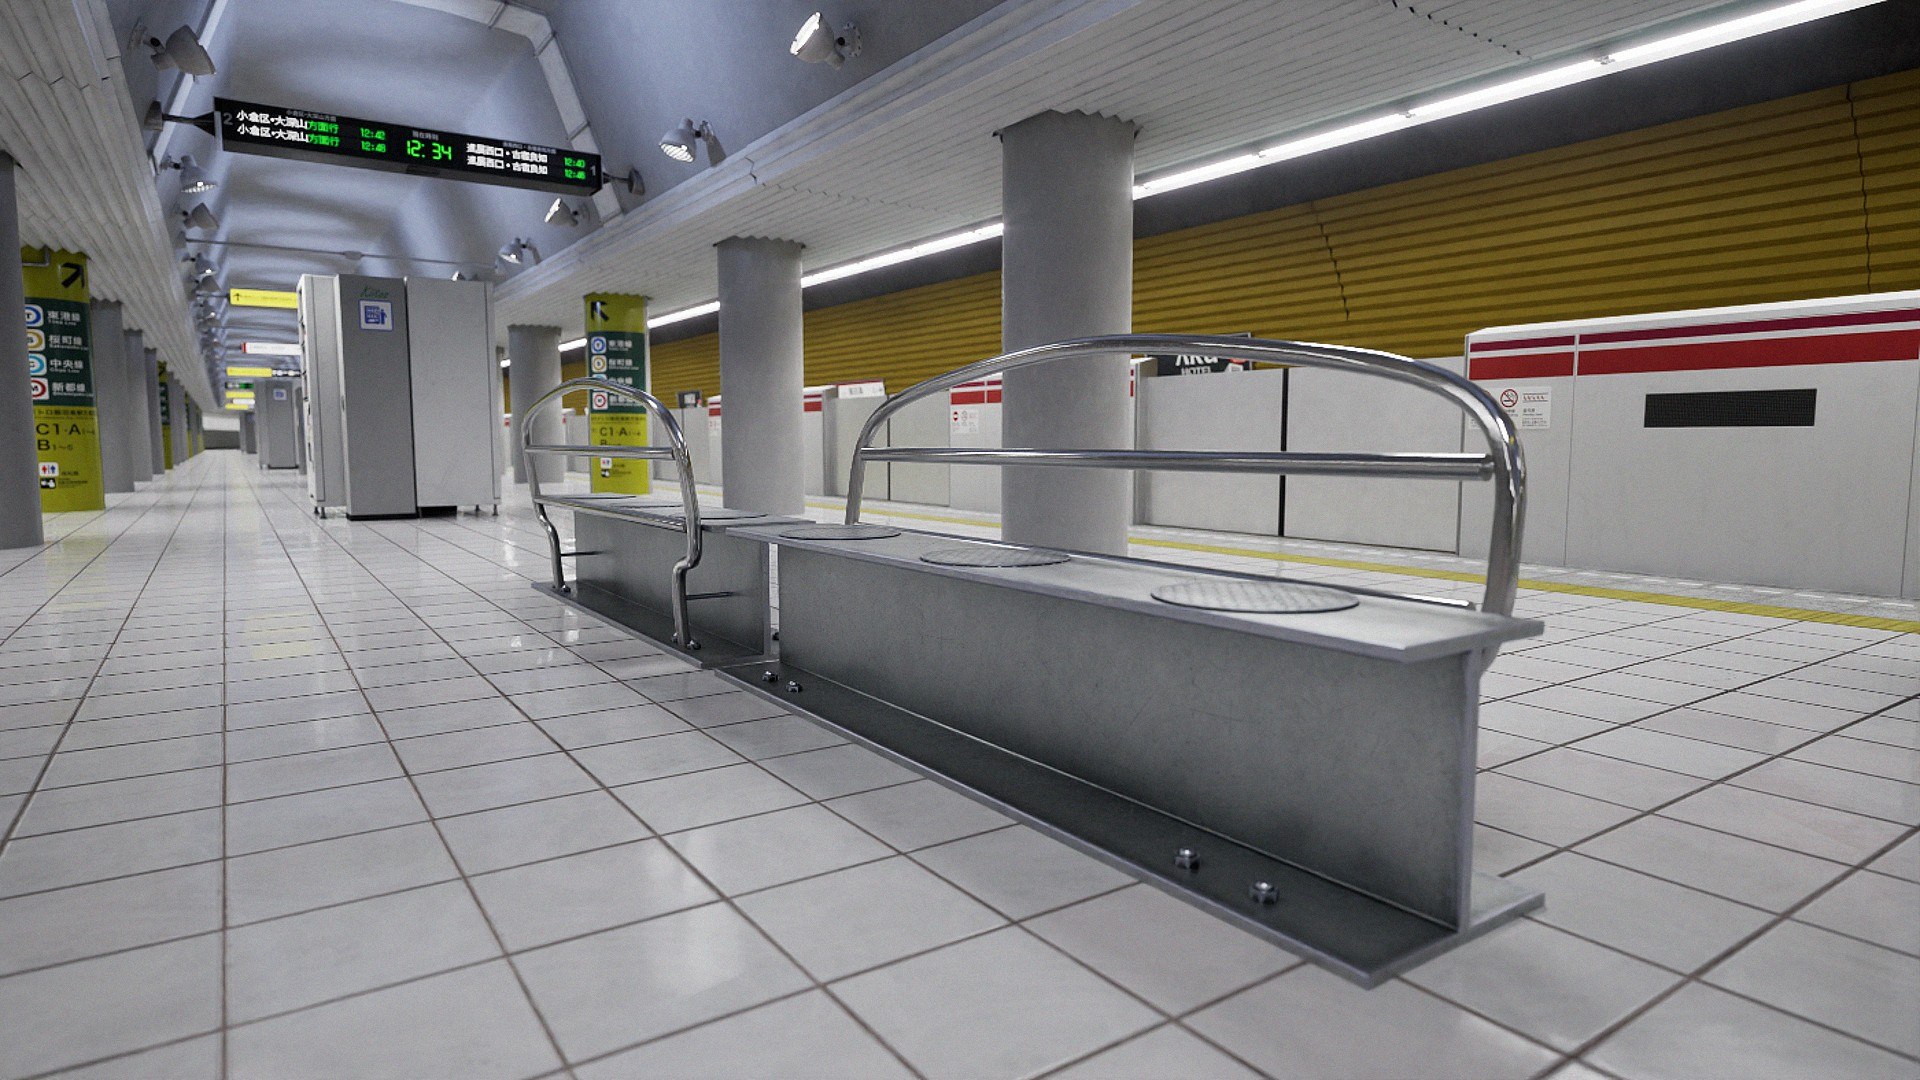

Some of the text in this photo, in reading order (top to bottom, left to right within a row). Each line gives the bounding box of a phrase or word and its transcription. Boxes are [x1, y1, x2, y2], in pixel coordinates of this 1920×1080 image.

[223, 112, 233, 126] 2
[406, 139, 453, 161] 12:34
[589, 165, 597, 177] 1
[49, 358, 85, 369] 中央線
